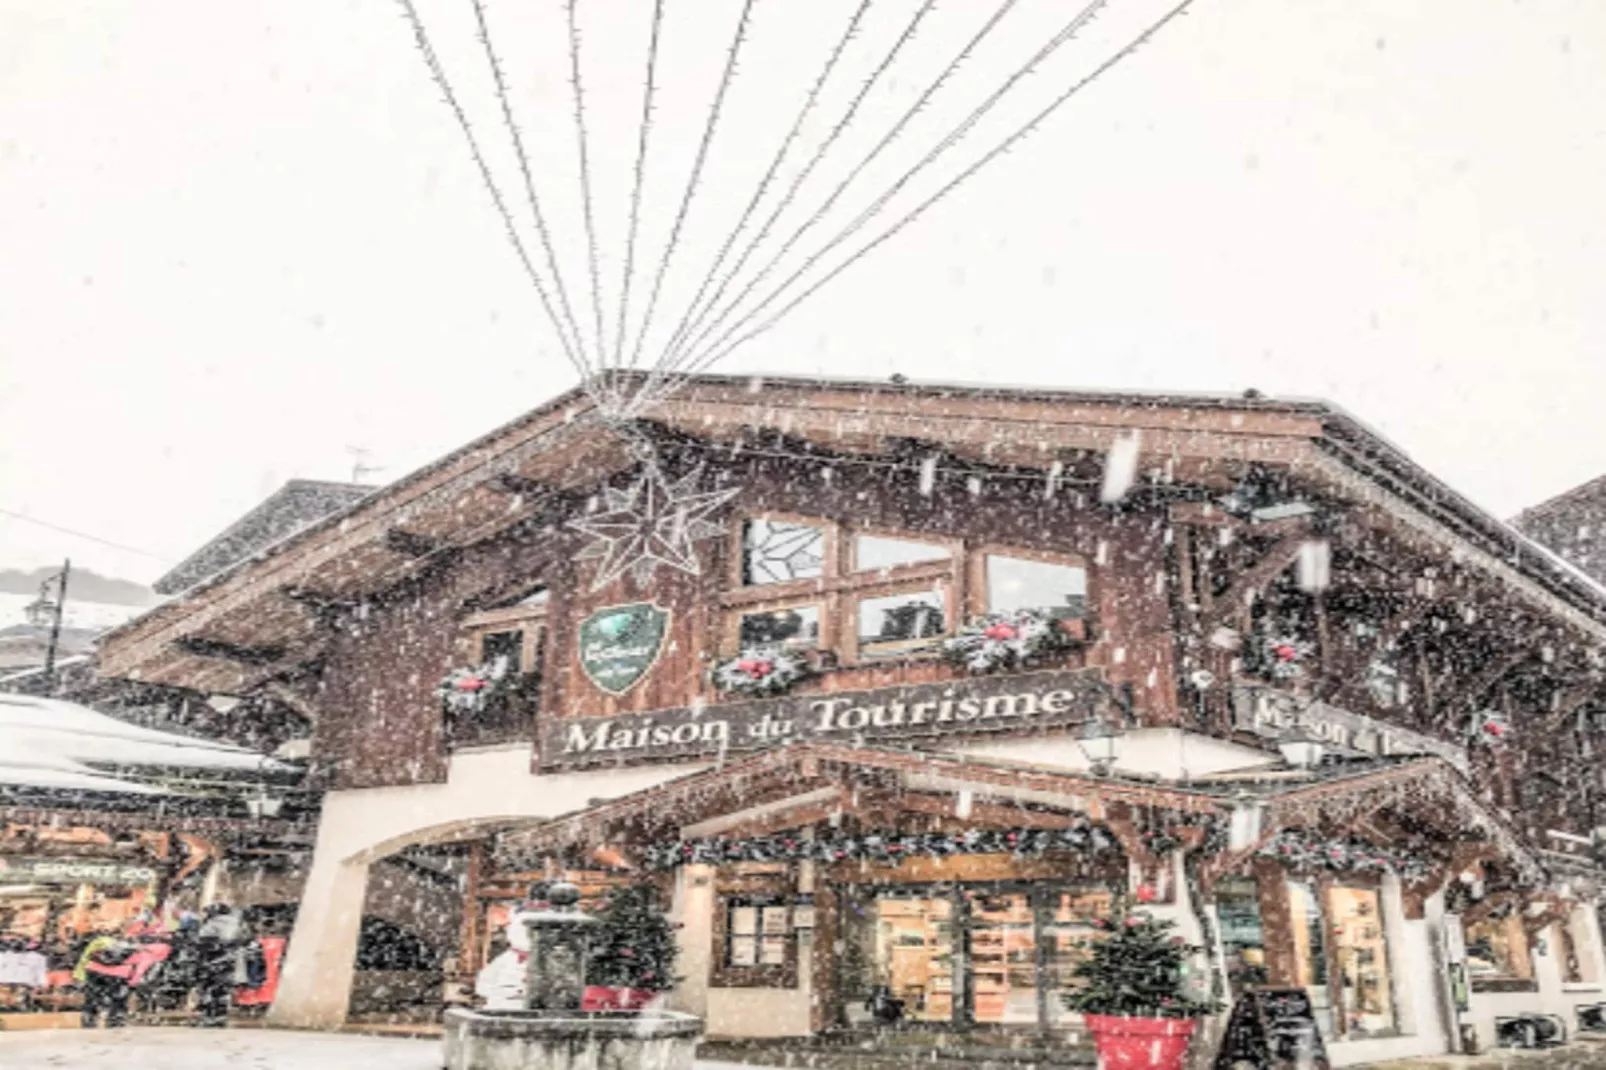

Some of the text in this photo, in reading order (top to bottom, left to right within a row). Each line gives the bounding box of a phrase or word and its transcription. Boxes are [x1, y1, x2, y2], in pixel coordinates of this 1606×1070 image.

[564, 688, 1075, 753] Maison du Tourisme
